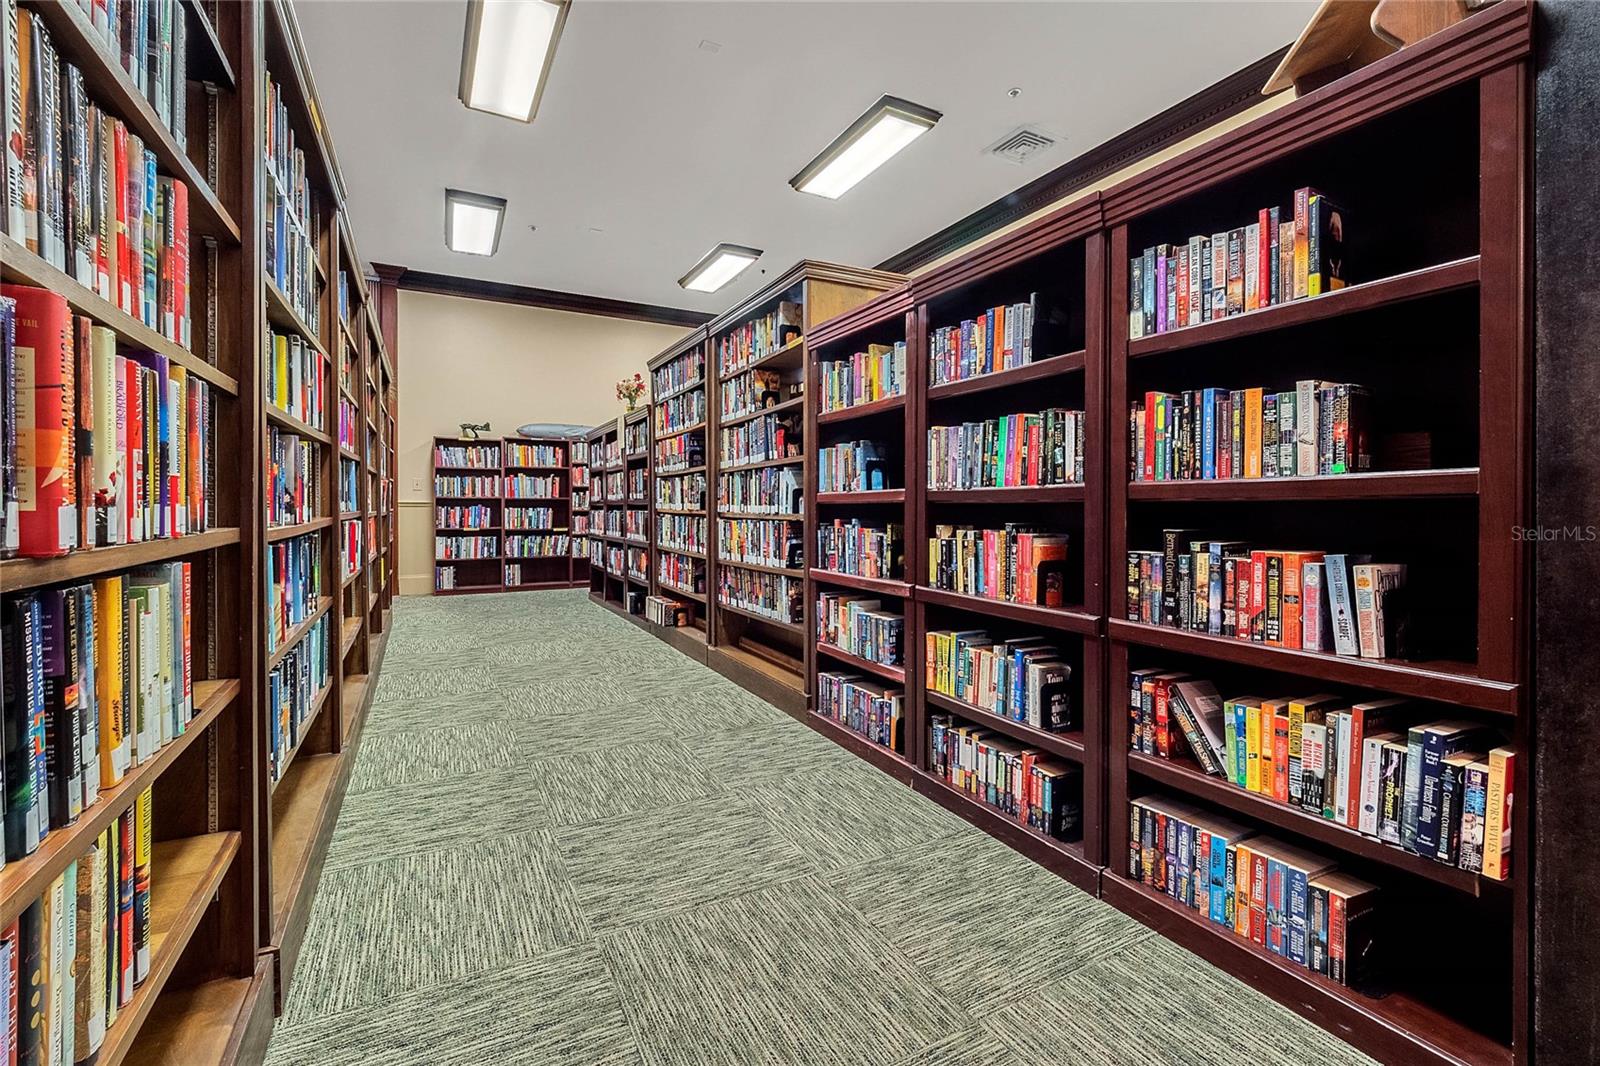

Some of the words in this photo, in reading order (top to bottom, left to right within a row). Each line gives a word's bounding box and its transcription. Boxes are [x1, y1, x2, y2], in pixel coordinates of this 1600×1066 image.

[1190, 290, 1198, 314] HOME
[1166, 534, 1176, 560] Bernard
[1165, 562, 1176, 592] Cornwell
[24, 611, 32, 664] MISSING
[28, 720, 36, 771] ALAFAIR
[72, 709, 80, 748] PURPLE
[1303, 738, 1312, 769] CRICHTON
[1314, 742, 1322, 769] MICHAEL
[1384, 781, 1395, 820] PROPHET
[1424, 776, 1438, 803] Darkness
[1490, 782, 1500, 822] PASTORS'
[1420, 803, 1437, 824] Falling
[1488, 824, 1498, 854] WIVES
